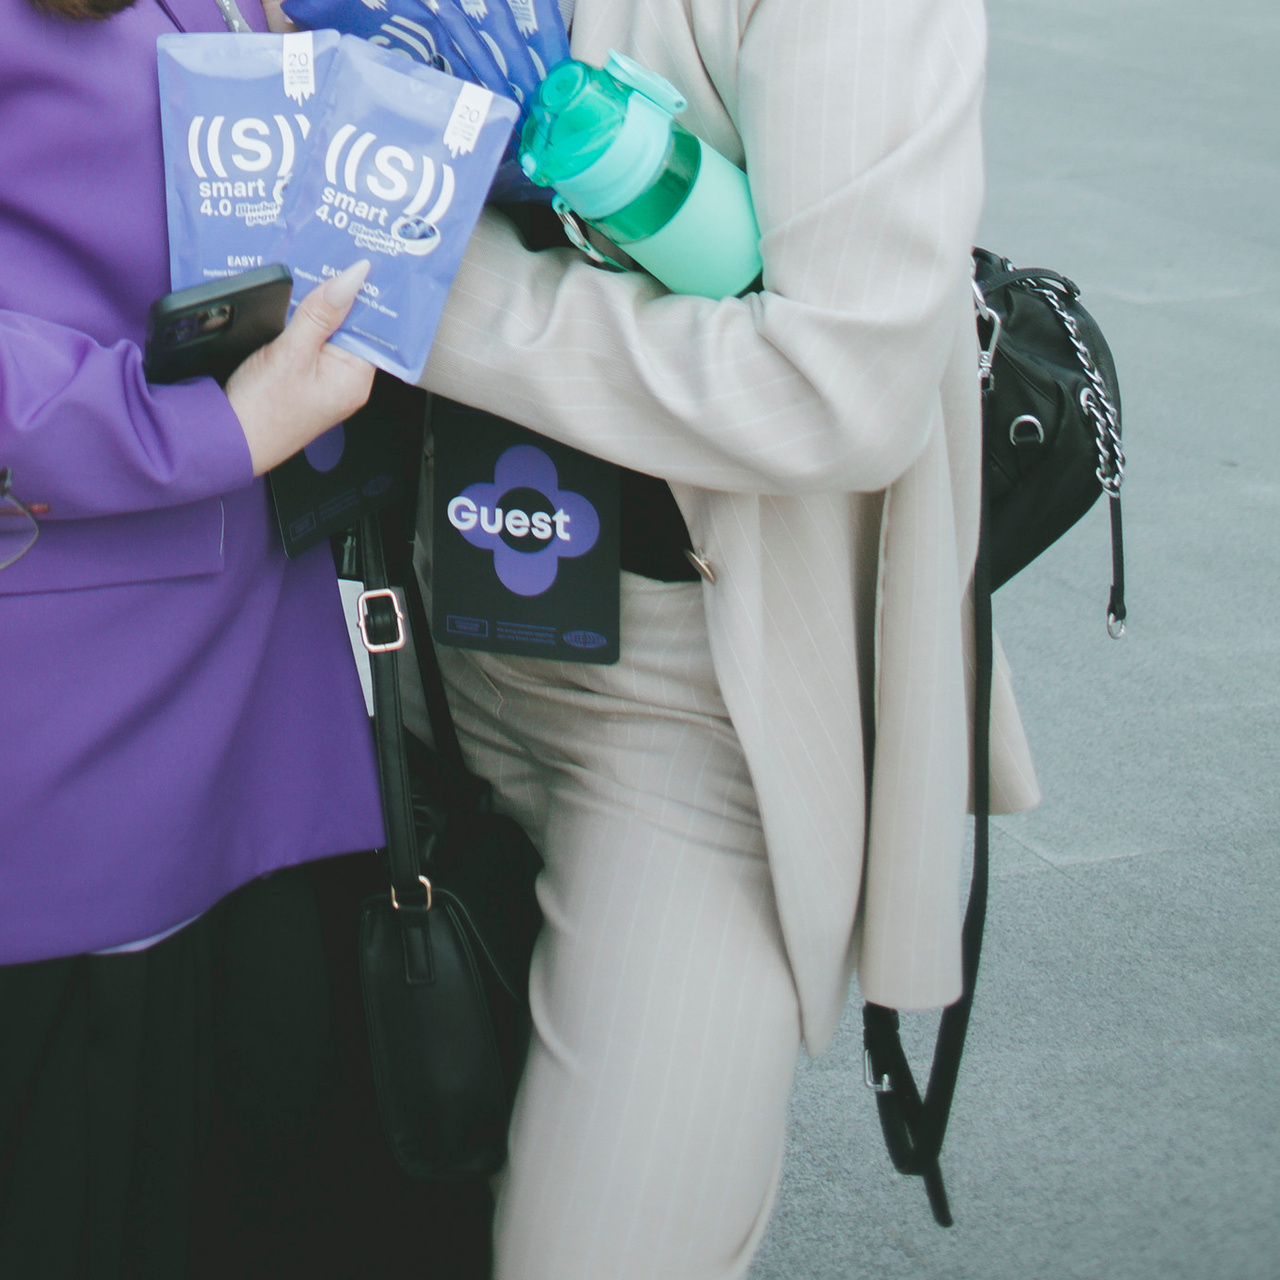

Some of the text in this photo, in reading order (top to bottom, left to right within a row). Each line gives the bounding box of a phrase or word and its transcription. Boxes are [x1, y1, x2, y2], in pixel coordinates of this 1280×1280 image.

[288, 52, 309, 67] 20
[199, 178, 266, 198] smart
[200, 199, 232, 217] 4.0
[321, 186, 389, 226] smart
[315, 204, 348, 229] 4.0
[227, 255, 256, 268] EASY
[447, 495, 571, 541] Guest
